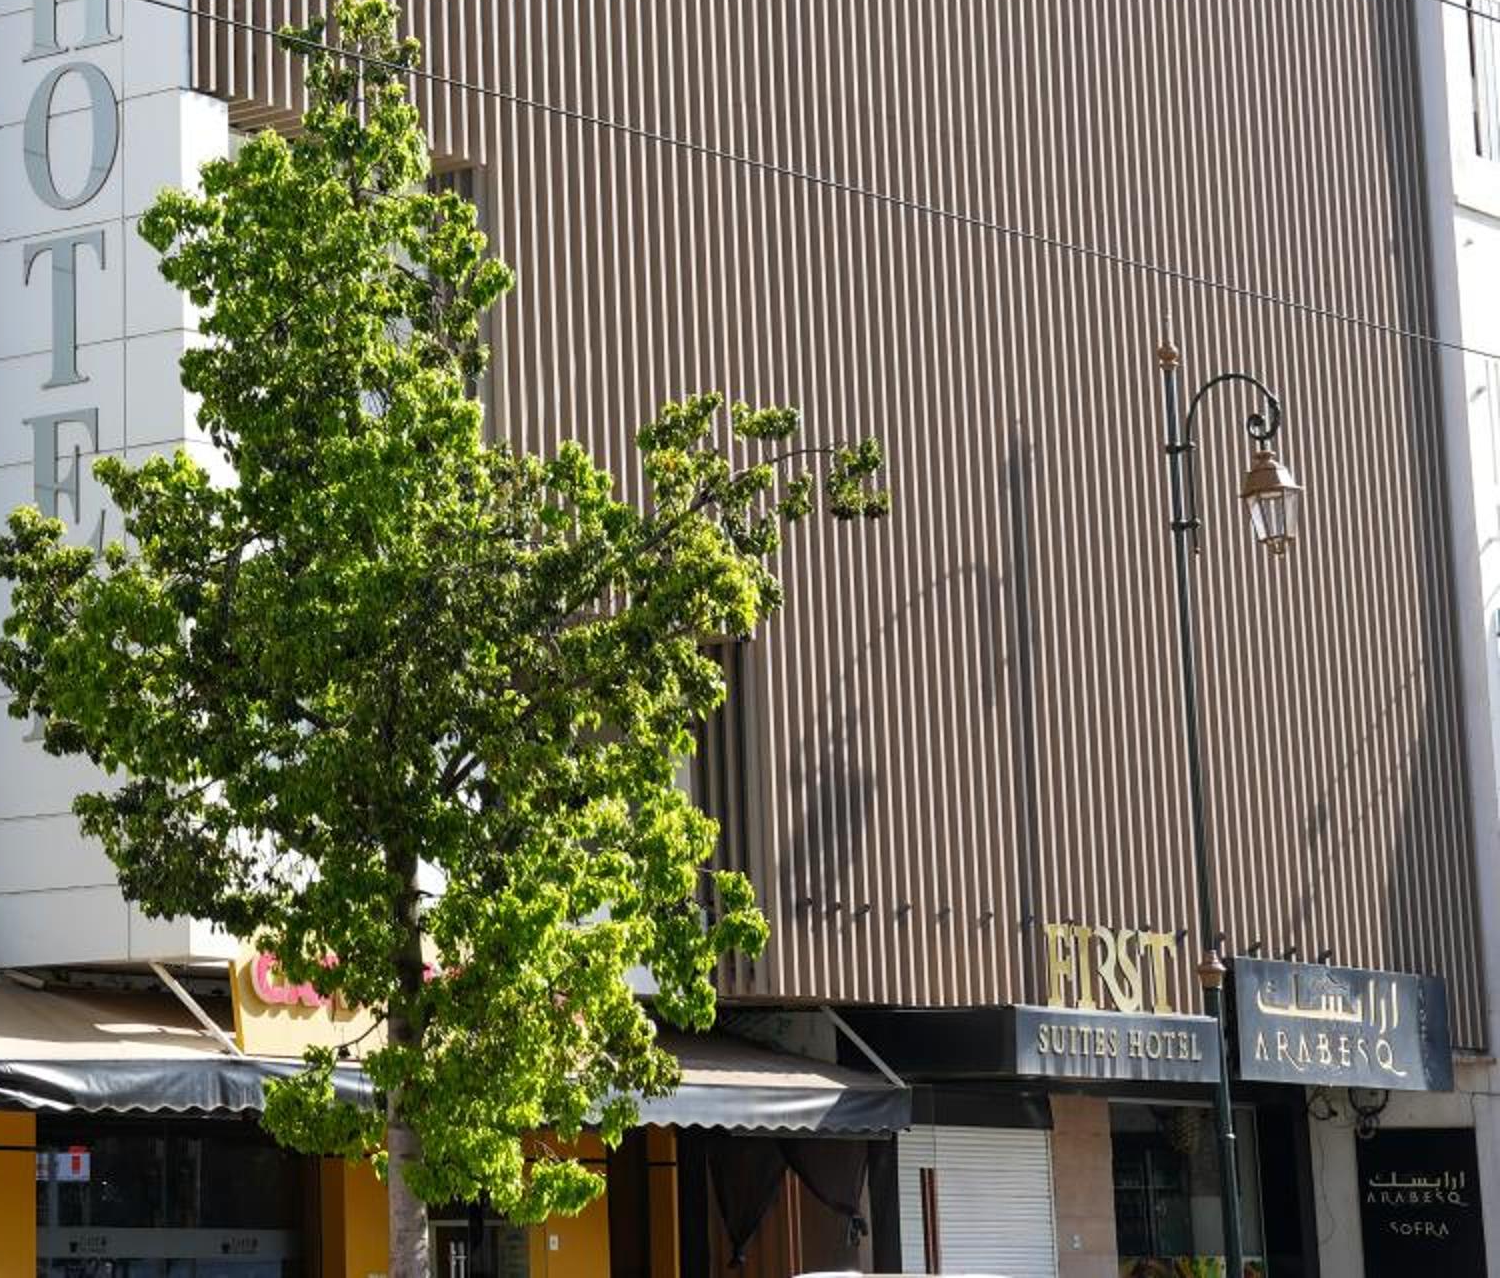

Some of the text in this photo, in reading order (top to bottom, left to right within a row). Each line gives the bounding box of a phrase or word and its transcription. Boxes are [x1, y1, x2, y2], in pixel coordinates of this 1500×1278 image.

[1044, 923, 1177, 1016] FIRST
[1038, 1023, 1203, 1063] SUITES HOTEL
[1255, 1031, 1408, 1077] ARABESQ
[1367, 1189, 1470, 1208] ARABESQ
[1388, 1221, 1450, 1240] SOFRA
